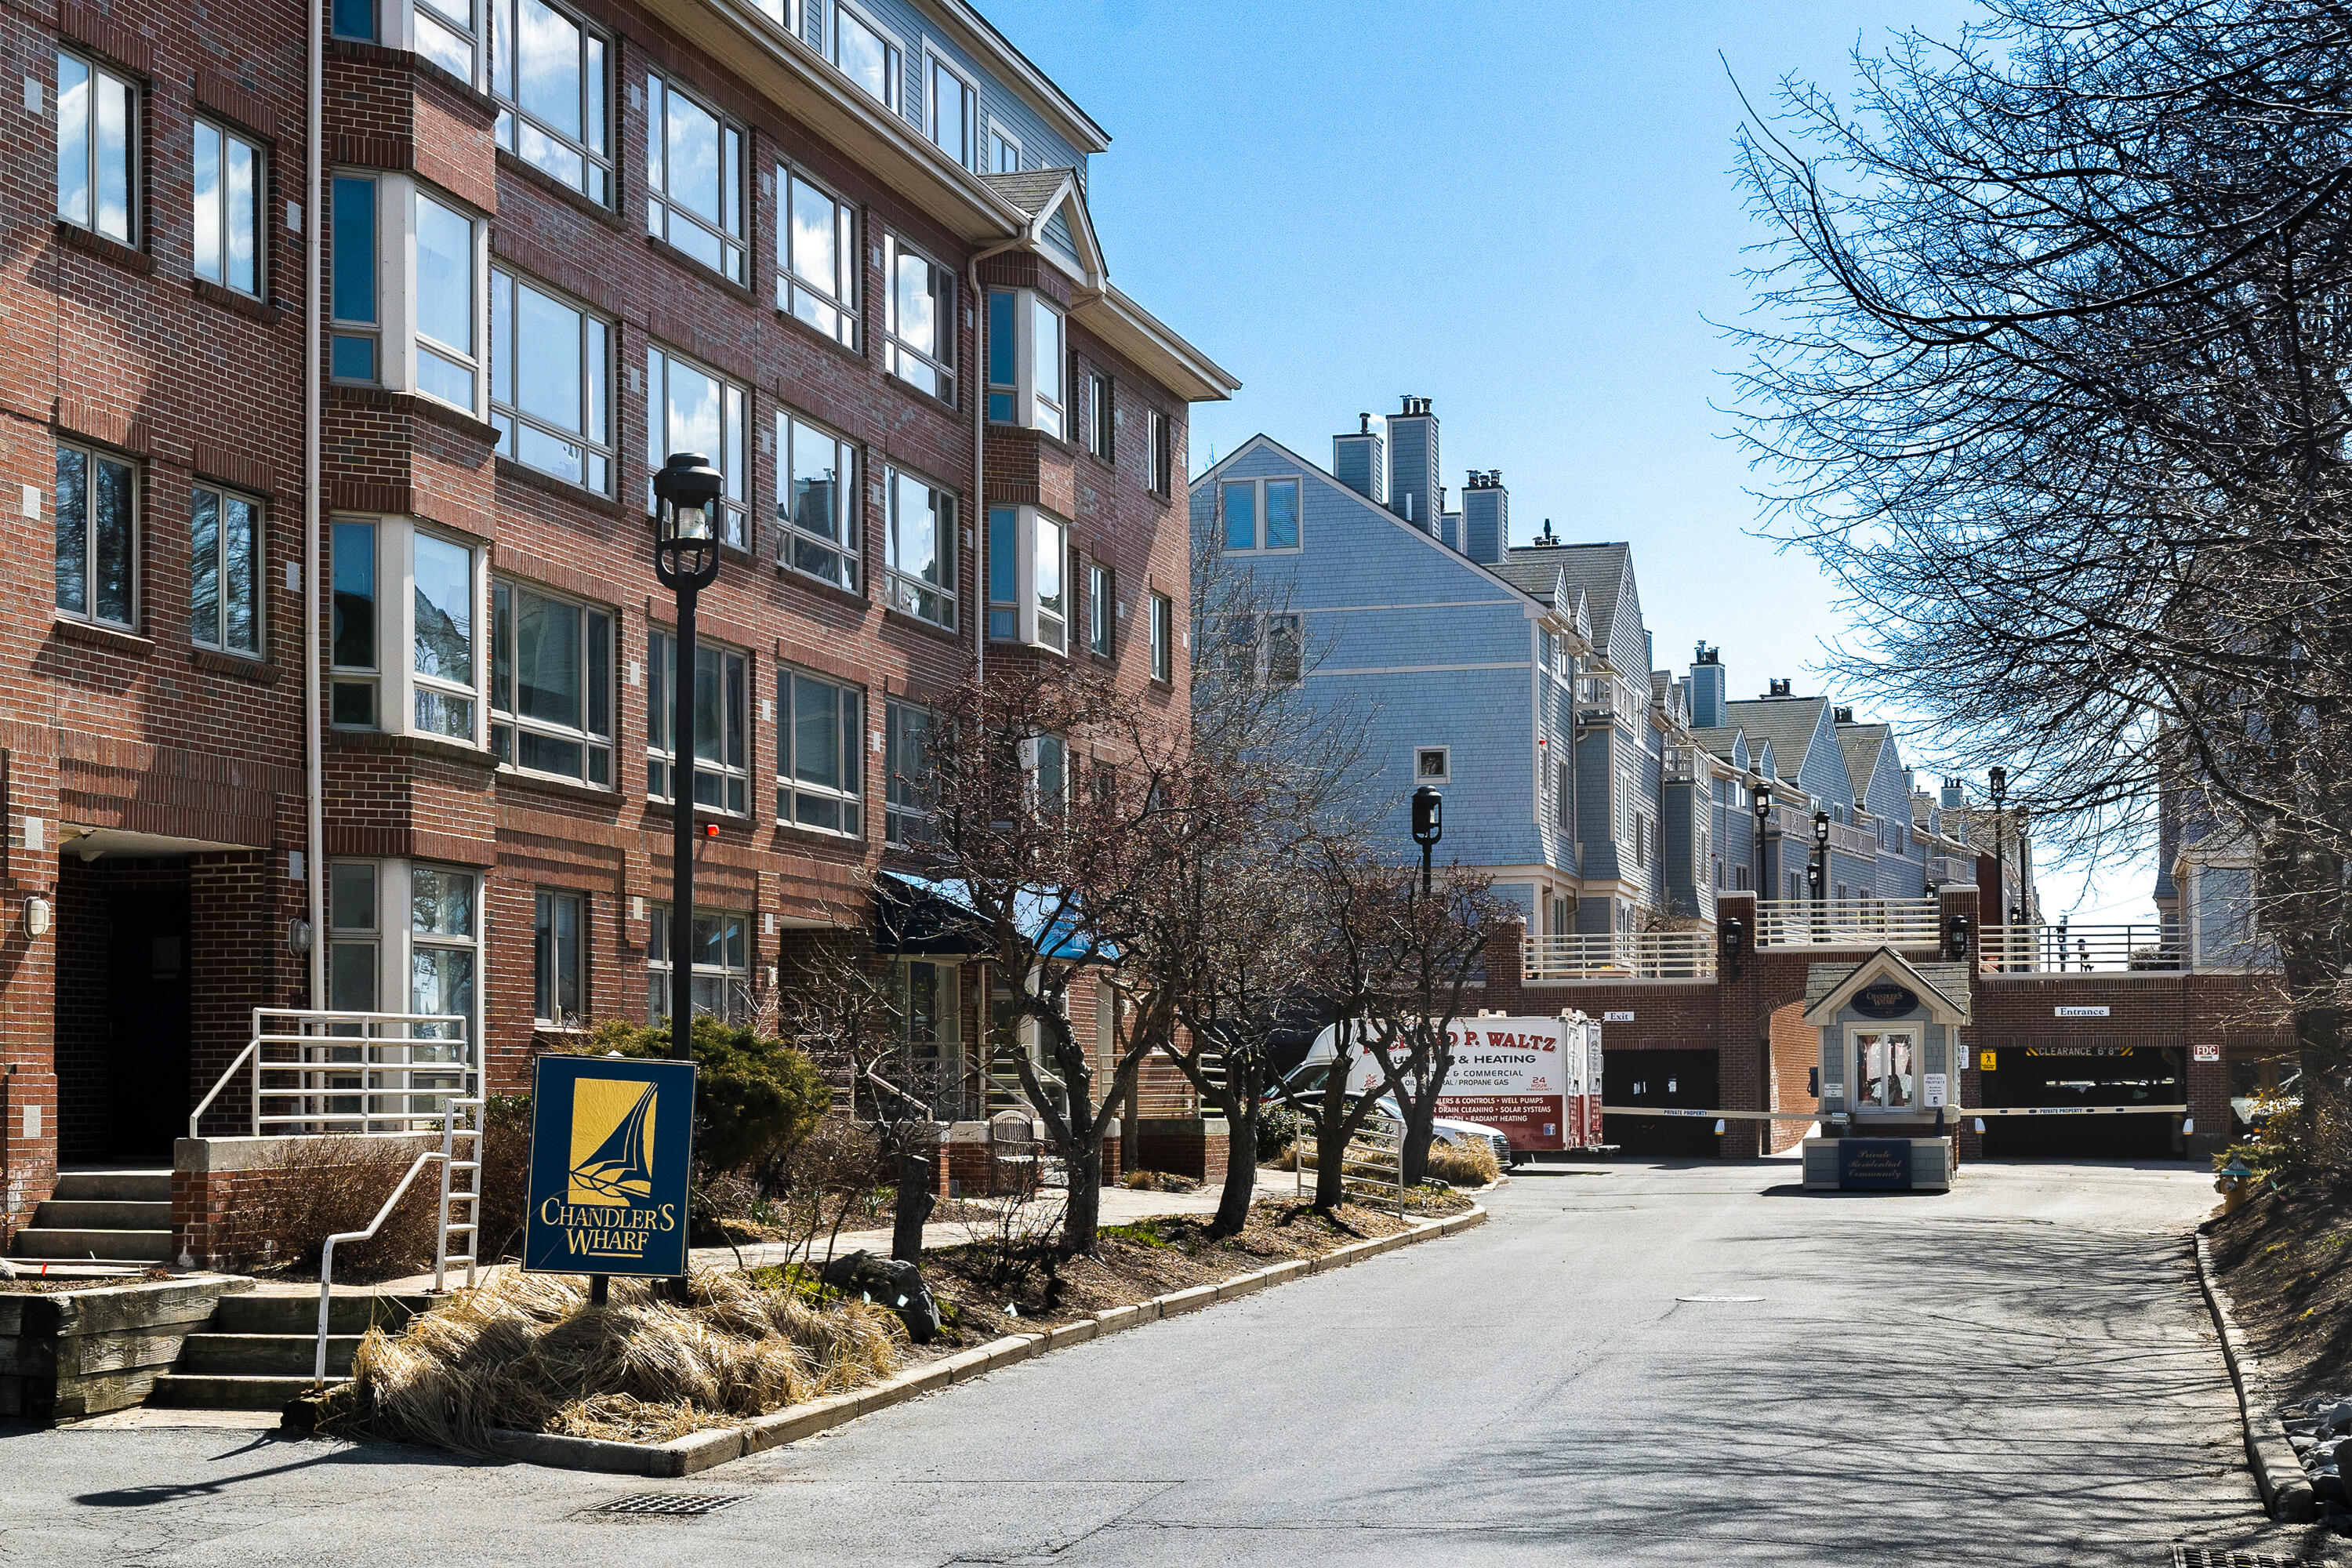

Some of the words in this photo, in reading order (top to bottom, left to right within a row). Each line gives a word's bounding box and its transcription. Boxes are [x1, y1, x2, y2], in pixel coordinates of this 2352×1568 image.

[1465, 1032, 1480, 1046] P.
[1486, 1032, 1556, 1052] WALTZ
[2038, 1047, 2092, 1055] CLEARANCE
[2197, 1046, 2216, 1054] FDC
[1458, 1055, 1468, 1064] &
[1474, 1054, 1537, 1064] HEATING
[1848, 1169, 1901, 1180] Community
[541, 1197, 675, 1232] CHANDLER'S
[565, 1228, 650, 1254] WHARF
